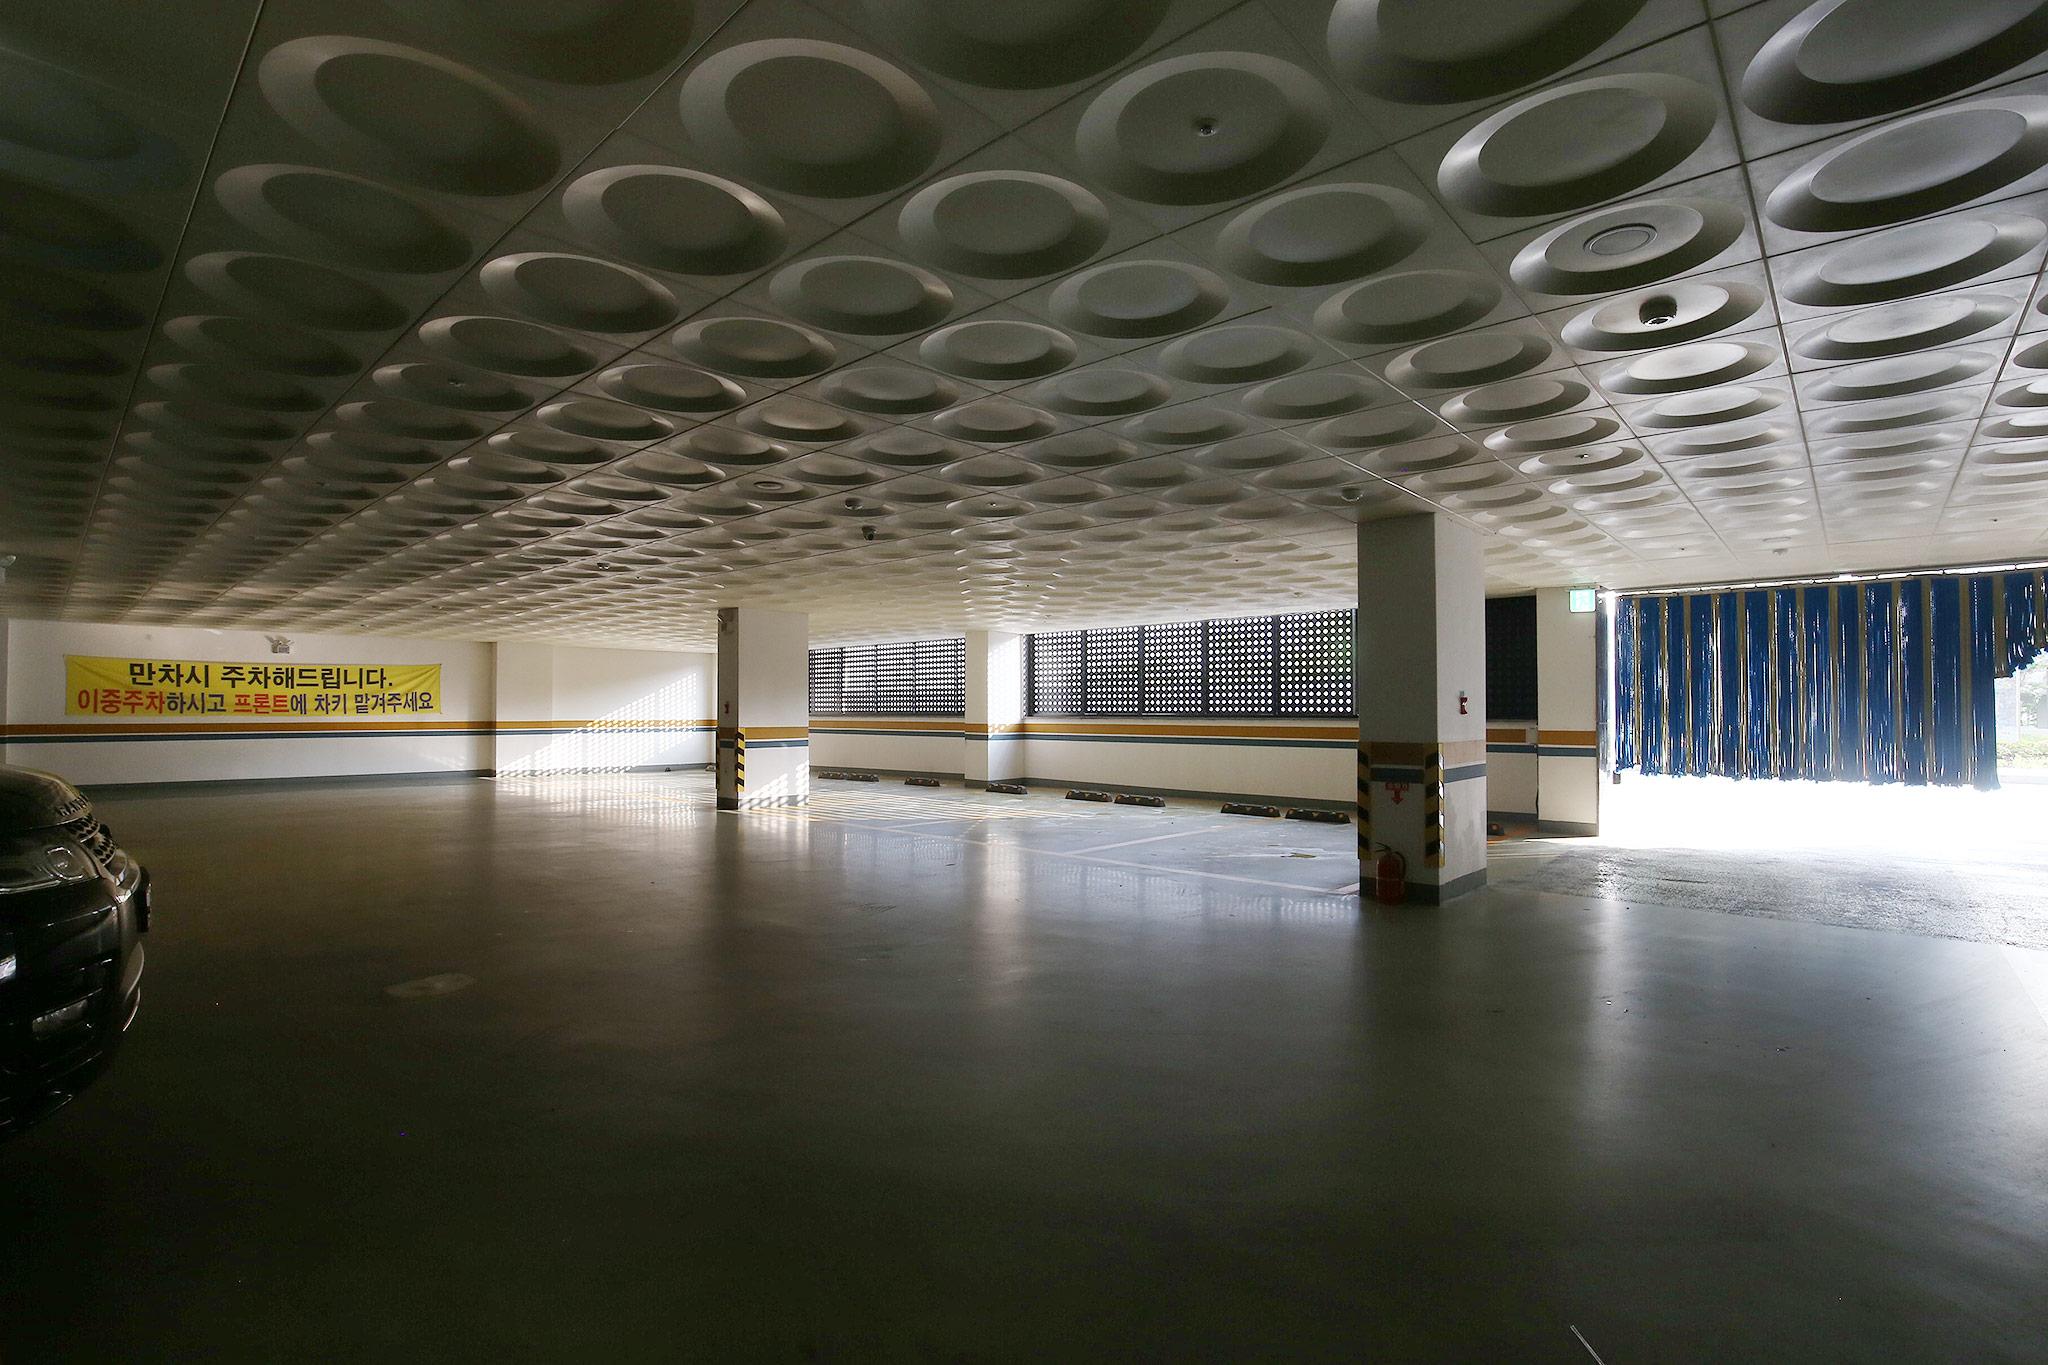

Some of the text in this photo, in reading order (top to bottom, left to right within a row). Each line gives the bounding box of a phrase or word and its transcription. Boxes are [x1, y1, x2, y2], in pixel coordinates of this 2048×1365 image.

[129, 662, 393, 689] 만차시 주차해드립니다.
[77, 688, 434, 715] 이중주차하시고 프론트에 차키 맡겨주세요
